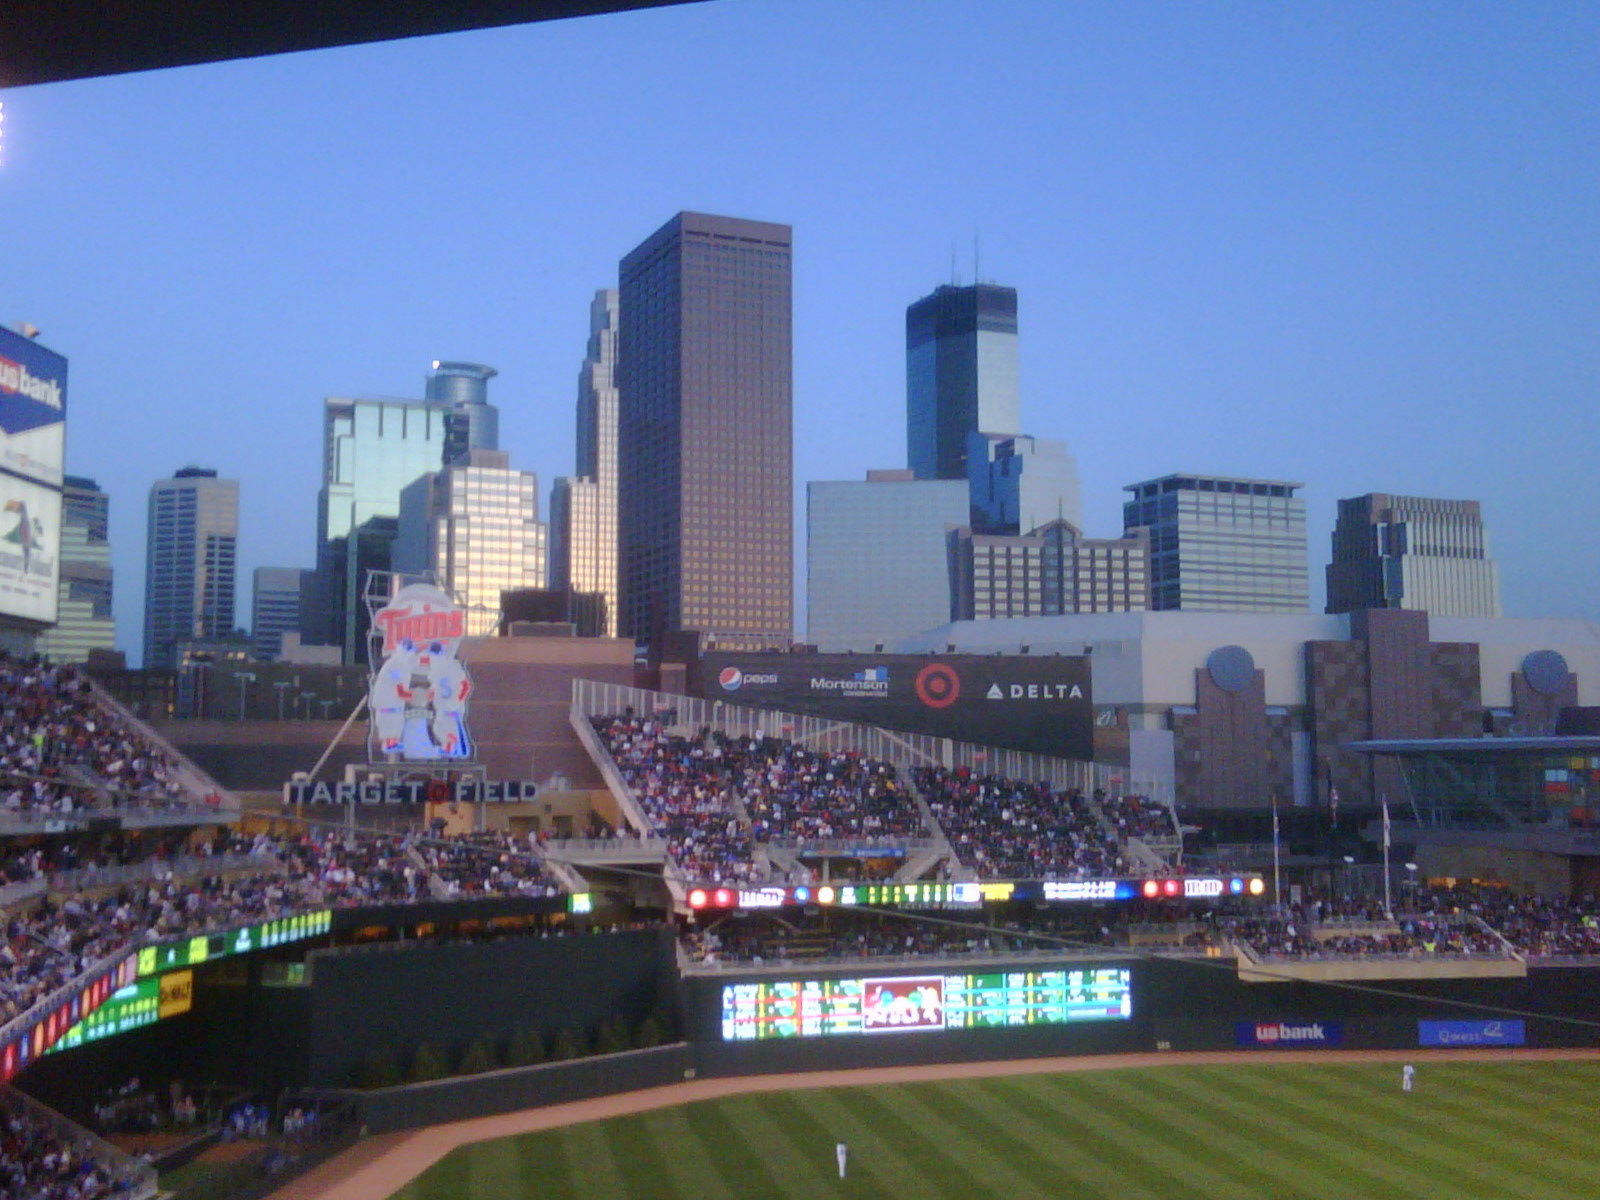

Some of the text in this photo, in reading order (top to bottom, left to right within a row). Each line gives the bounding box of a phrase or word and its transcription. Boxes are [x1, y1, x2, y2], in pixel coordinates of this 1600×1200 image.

[376, 606, 463, 650] Twins
[743, 673, 778, 684] pepsi
[810, 678, 888, 689] Mortenson
[1010, 684, 1083, 699] DELTA
[289, 780, 536, 804] TARGET FIELD
